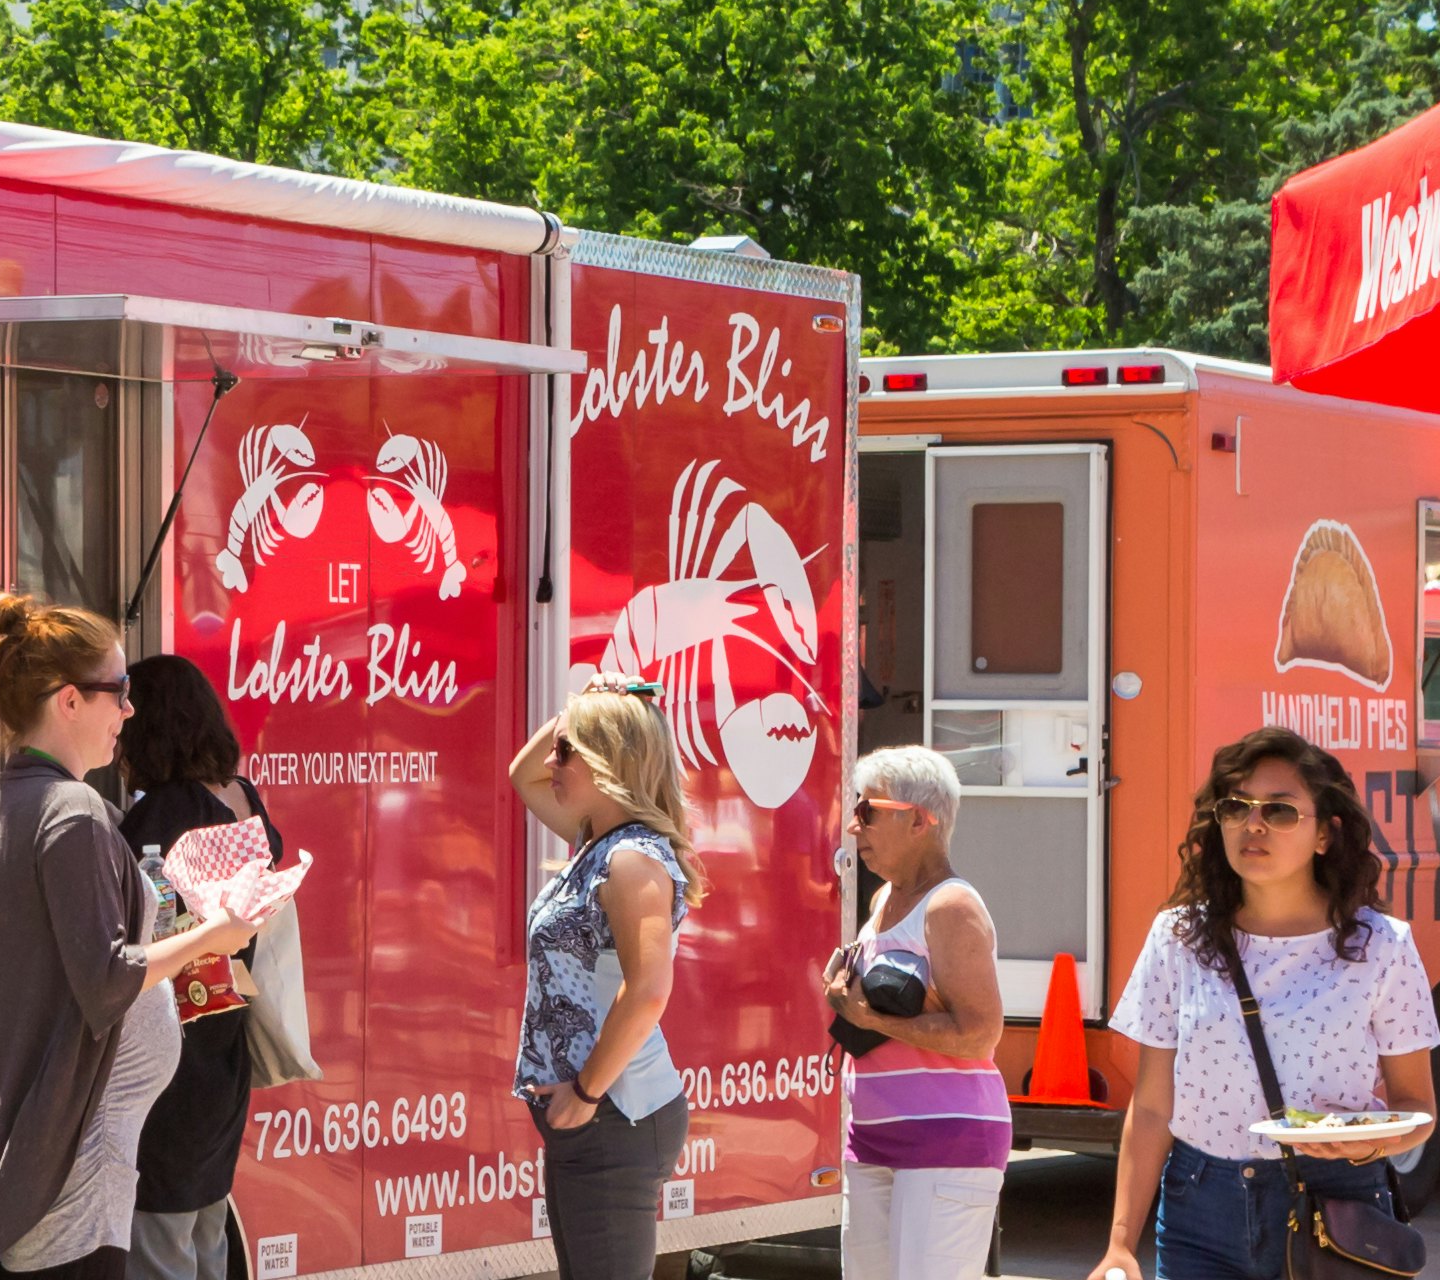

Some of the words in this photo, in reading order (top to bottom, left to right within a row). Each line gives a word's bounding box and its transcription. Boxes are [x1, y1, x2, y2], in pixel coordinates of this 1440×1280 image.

[570, 303, 709, 438] obster
[723, 312, 829, 463] Bliss
[329, 562, 361, 603] LET
[228, 618, 352, 704] Lobster
[365, 623, 458, 707] Bliss
[1262, 692, 1361, 749] HANDHELD
[1367, 699, 1407, 750] PIES
[249, 753, 298, 786] CATER
[302, 752, 344, 784] YOUR
[348, 752, 386, 783] NEXT
[390, 751, 438, 783] EVENT
[677, 1053, 835, 1112] 20.636.6456
[254, 1091, 467, 1162] 720.636.6493
[669, 1198, 689, 1211] WATER
[670, 1186, 687, 1198] GRAY
[408, 1222, 438, 1235] POTABLE
[412, 1235, 435, 1248] WATER
[260, 1240, 293, 1256] POTABLE
[264, 1256, 289, 1270] WATER
